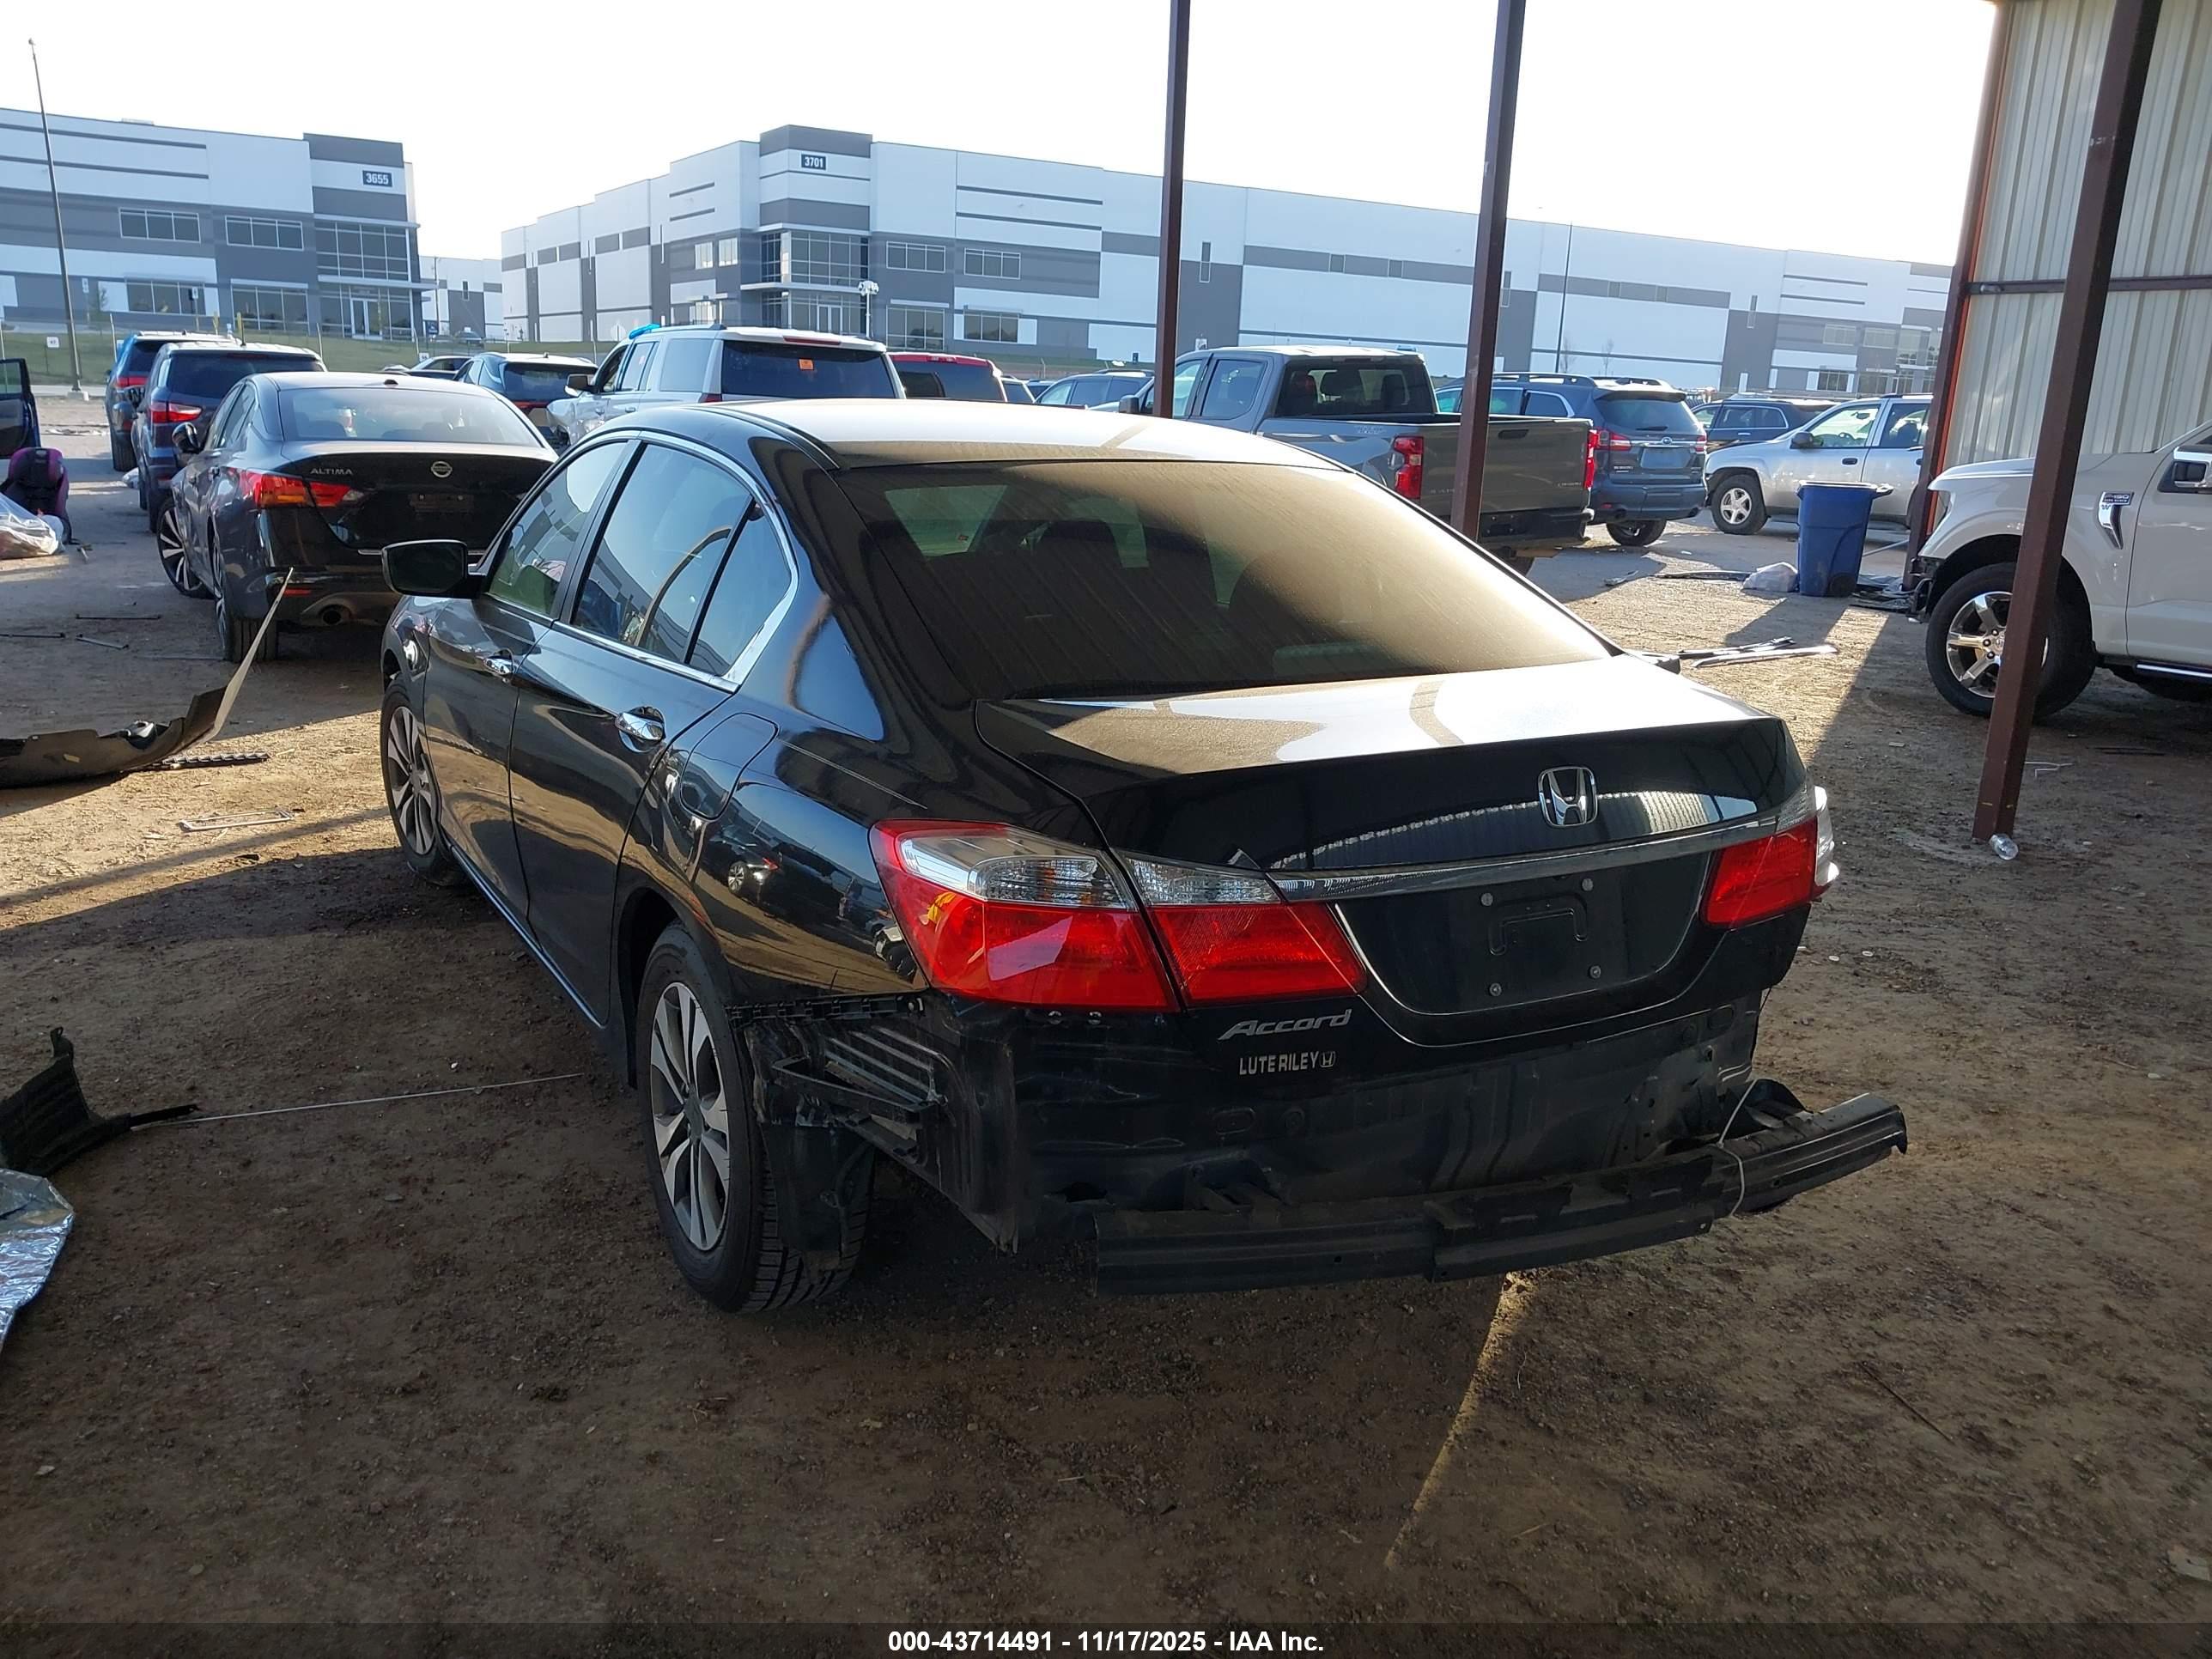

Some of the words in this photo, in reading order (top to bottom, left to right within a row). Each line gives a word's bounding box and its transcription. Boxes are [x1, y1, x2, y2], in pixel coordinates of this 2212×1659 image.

[805, 156, 823, 168] 3701
[366, 173, 389, 185] 3655
[1218, 1009, 1352, 1041] Accord
